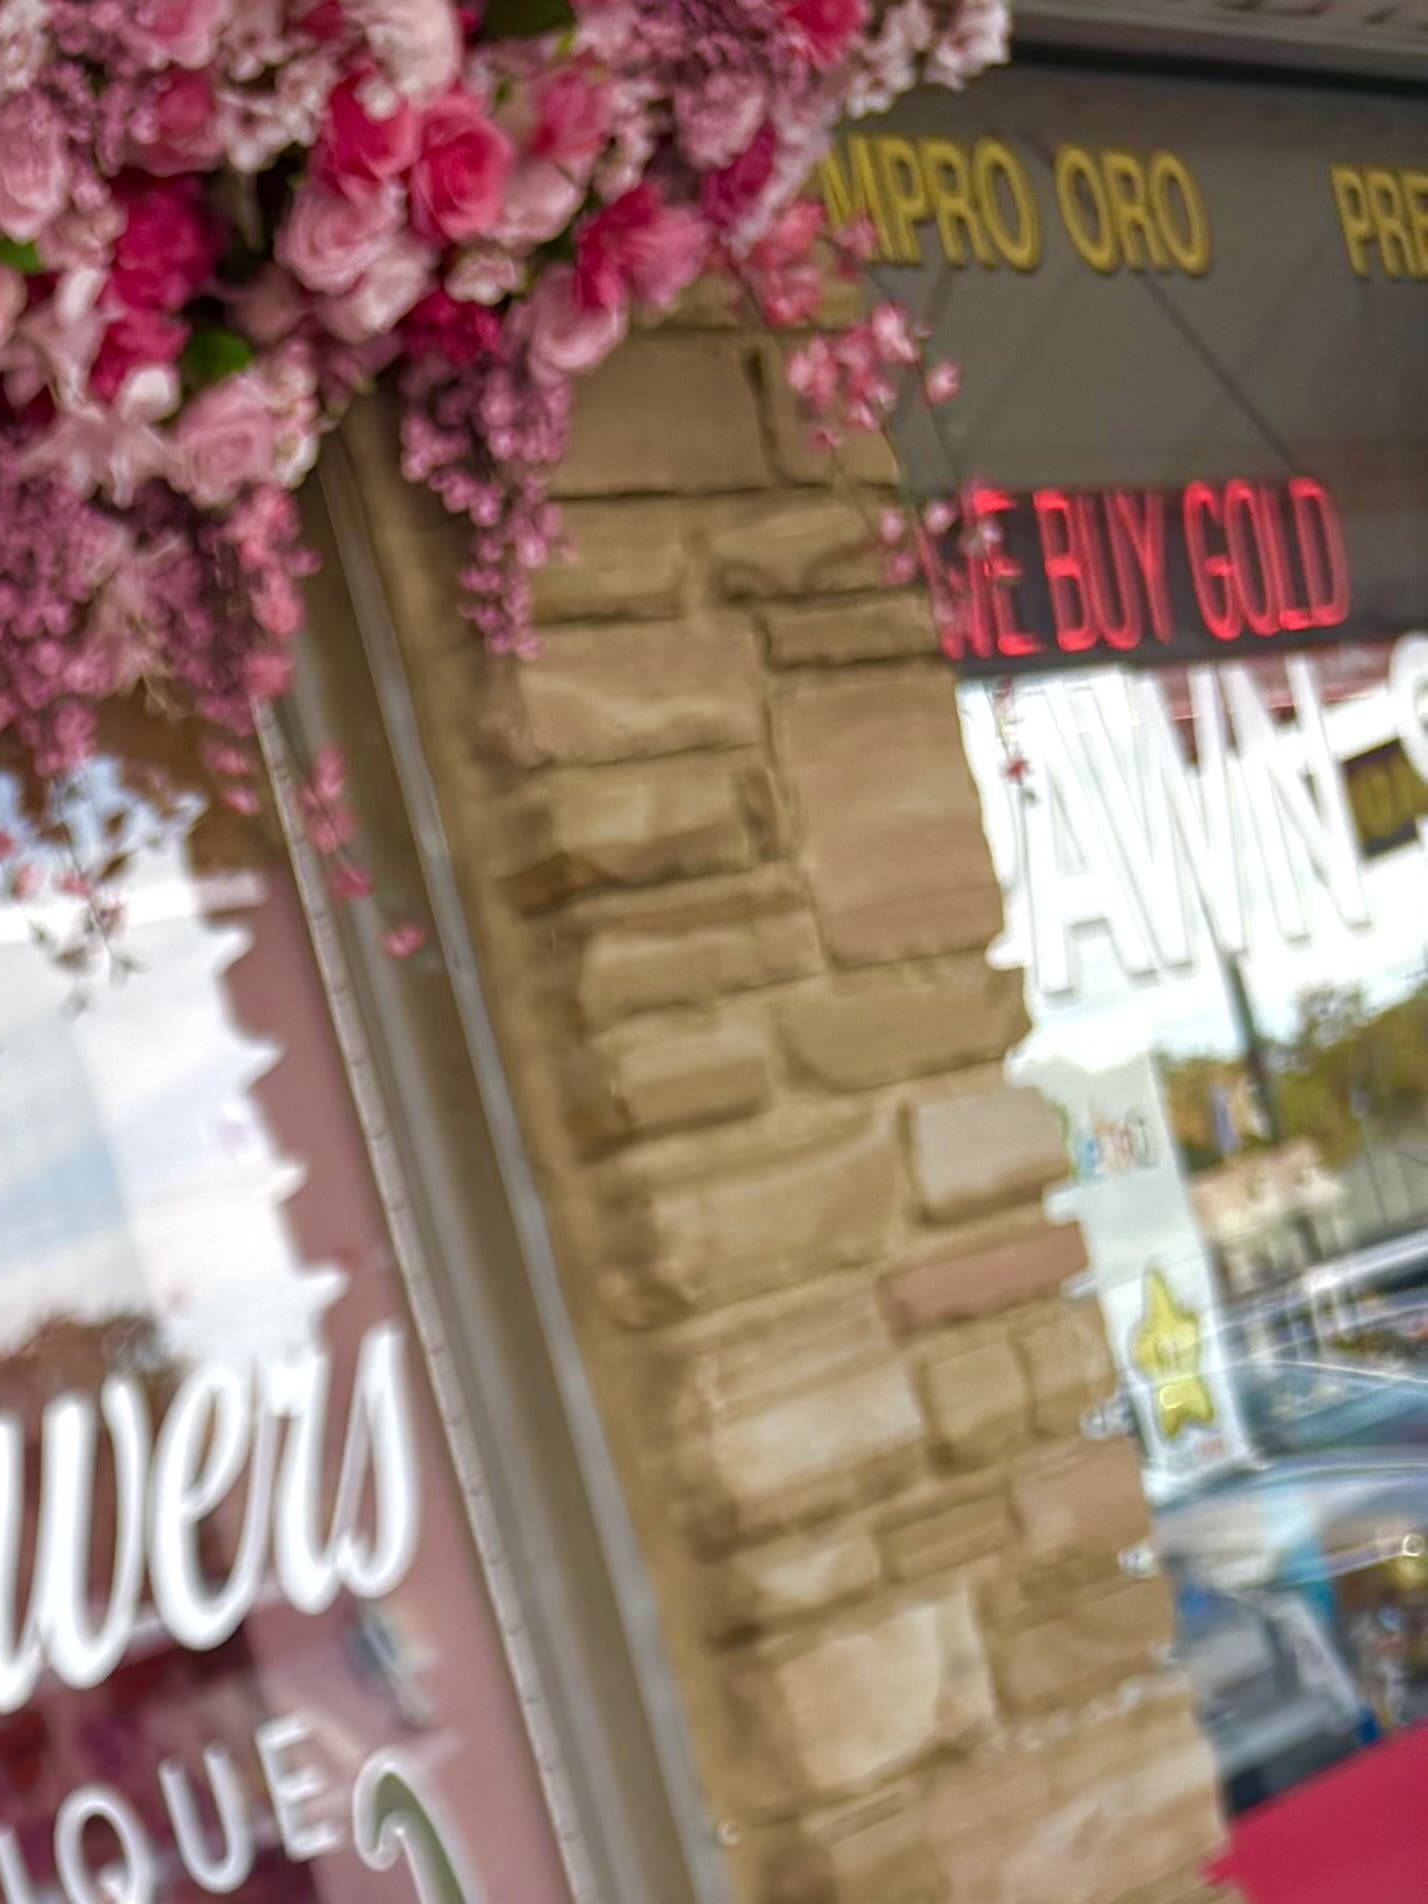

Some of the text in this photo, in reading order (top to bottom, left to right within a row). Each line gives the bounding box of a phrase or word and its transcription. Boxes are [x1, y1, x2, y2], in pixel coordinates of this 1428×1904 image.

[1055, 142, 1211, 277] ORO
[1033, 488, 1173, 651] BUY
[1182, 477, 1352, 641] GOLD
